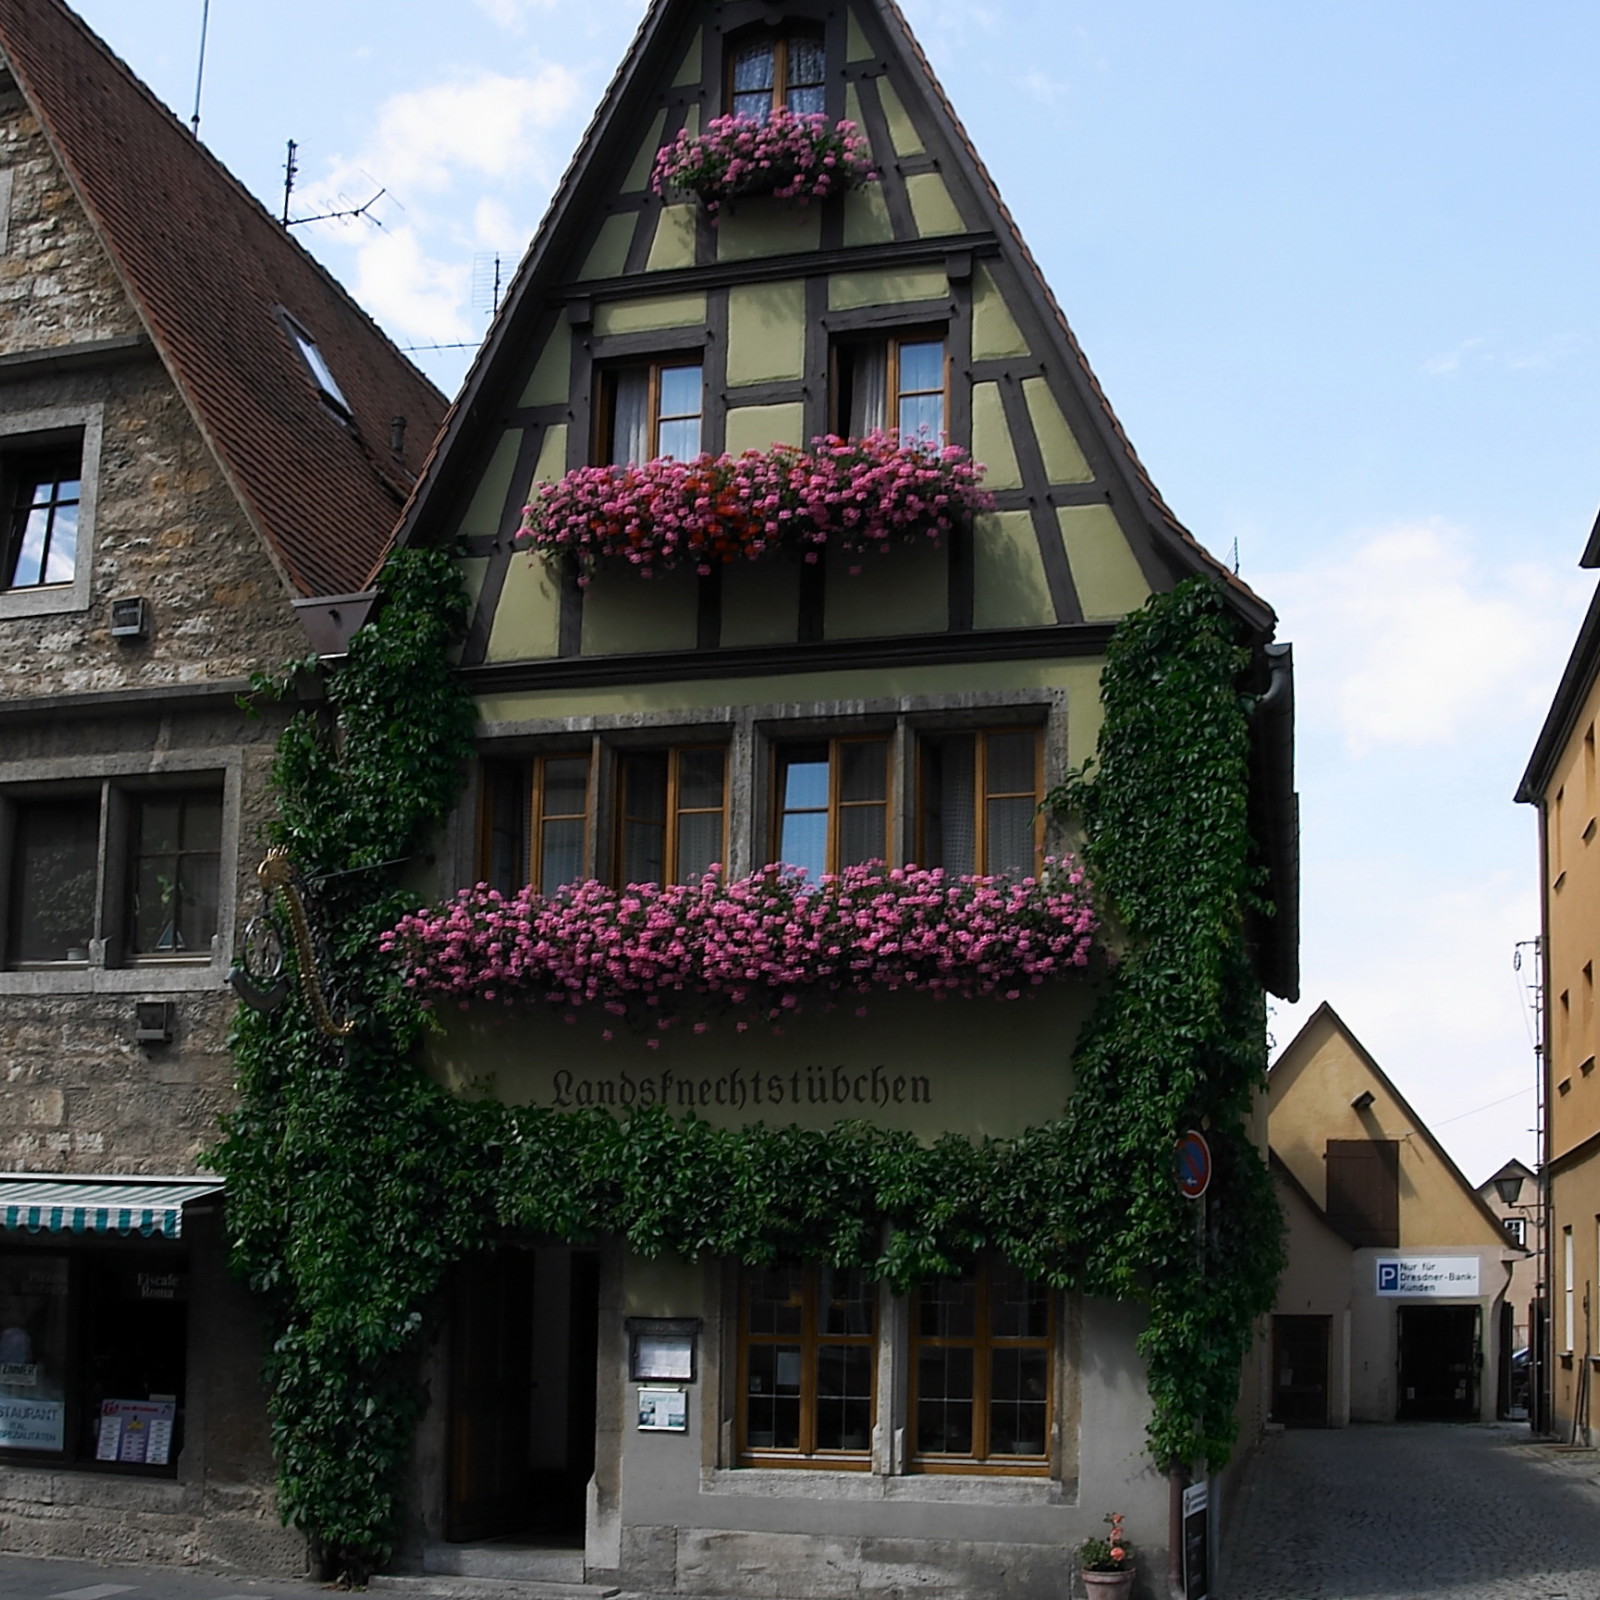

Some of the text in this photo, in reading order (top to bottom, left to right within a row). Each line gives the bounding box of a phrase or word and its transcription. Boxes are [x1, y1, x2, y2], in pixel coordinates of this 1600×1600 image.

[552, 1065, 932, 1109] Landsknechtstübchen
[1400, 1263, 1436, 1271] Nur für
[1381, 1267, 1396, 1287] P
[141, 1286, 174, 1298] Roma
[1400, 1284, 1436, 1292] Kunden
